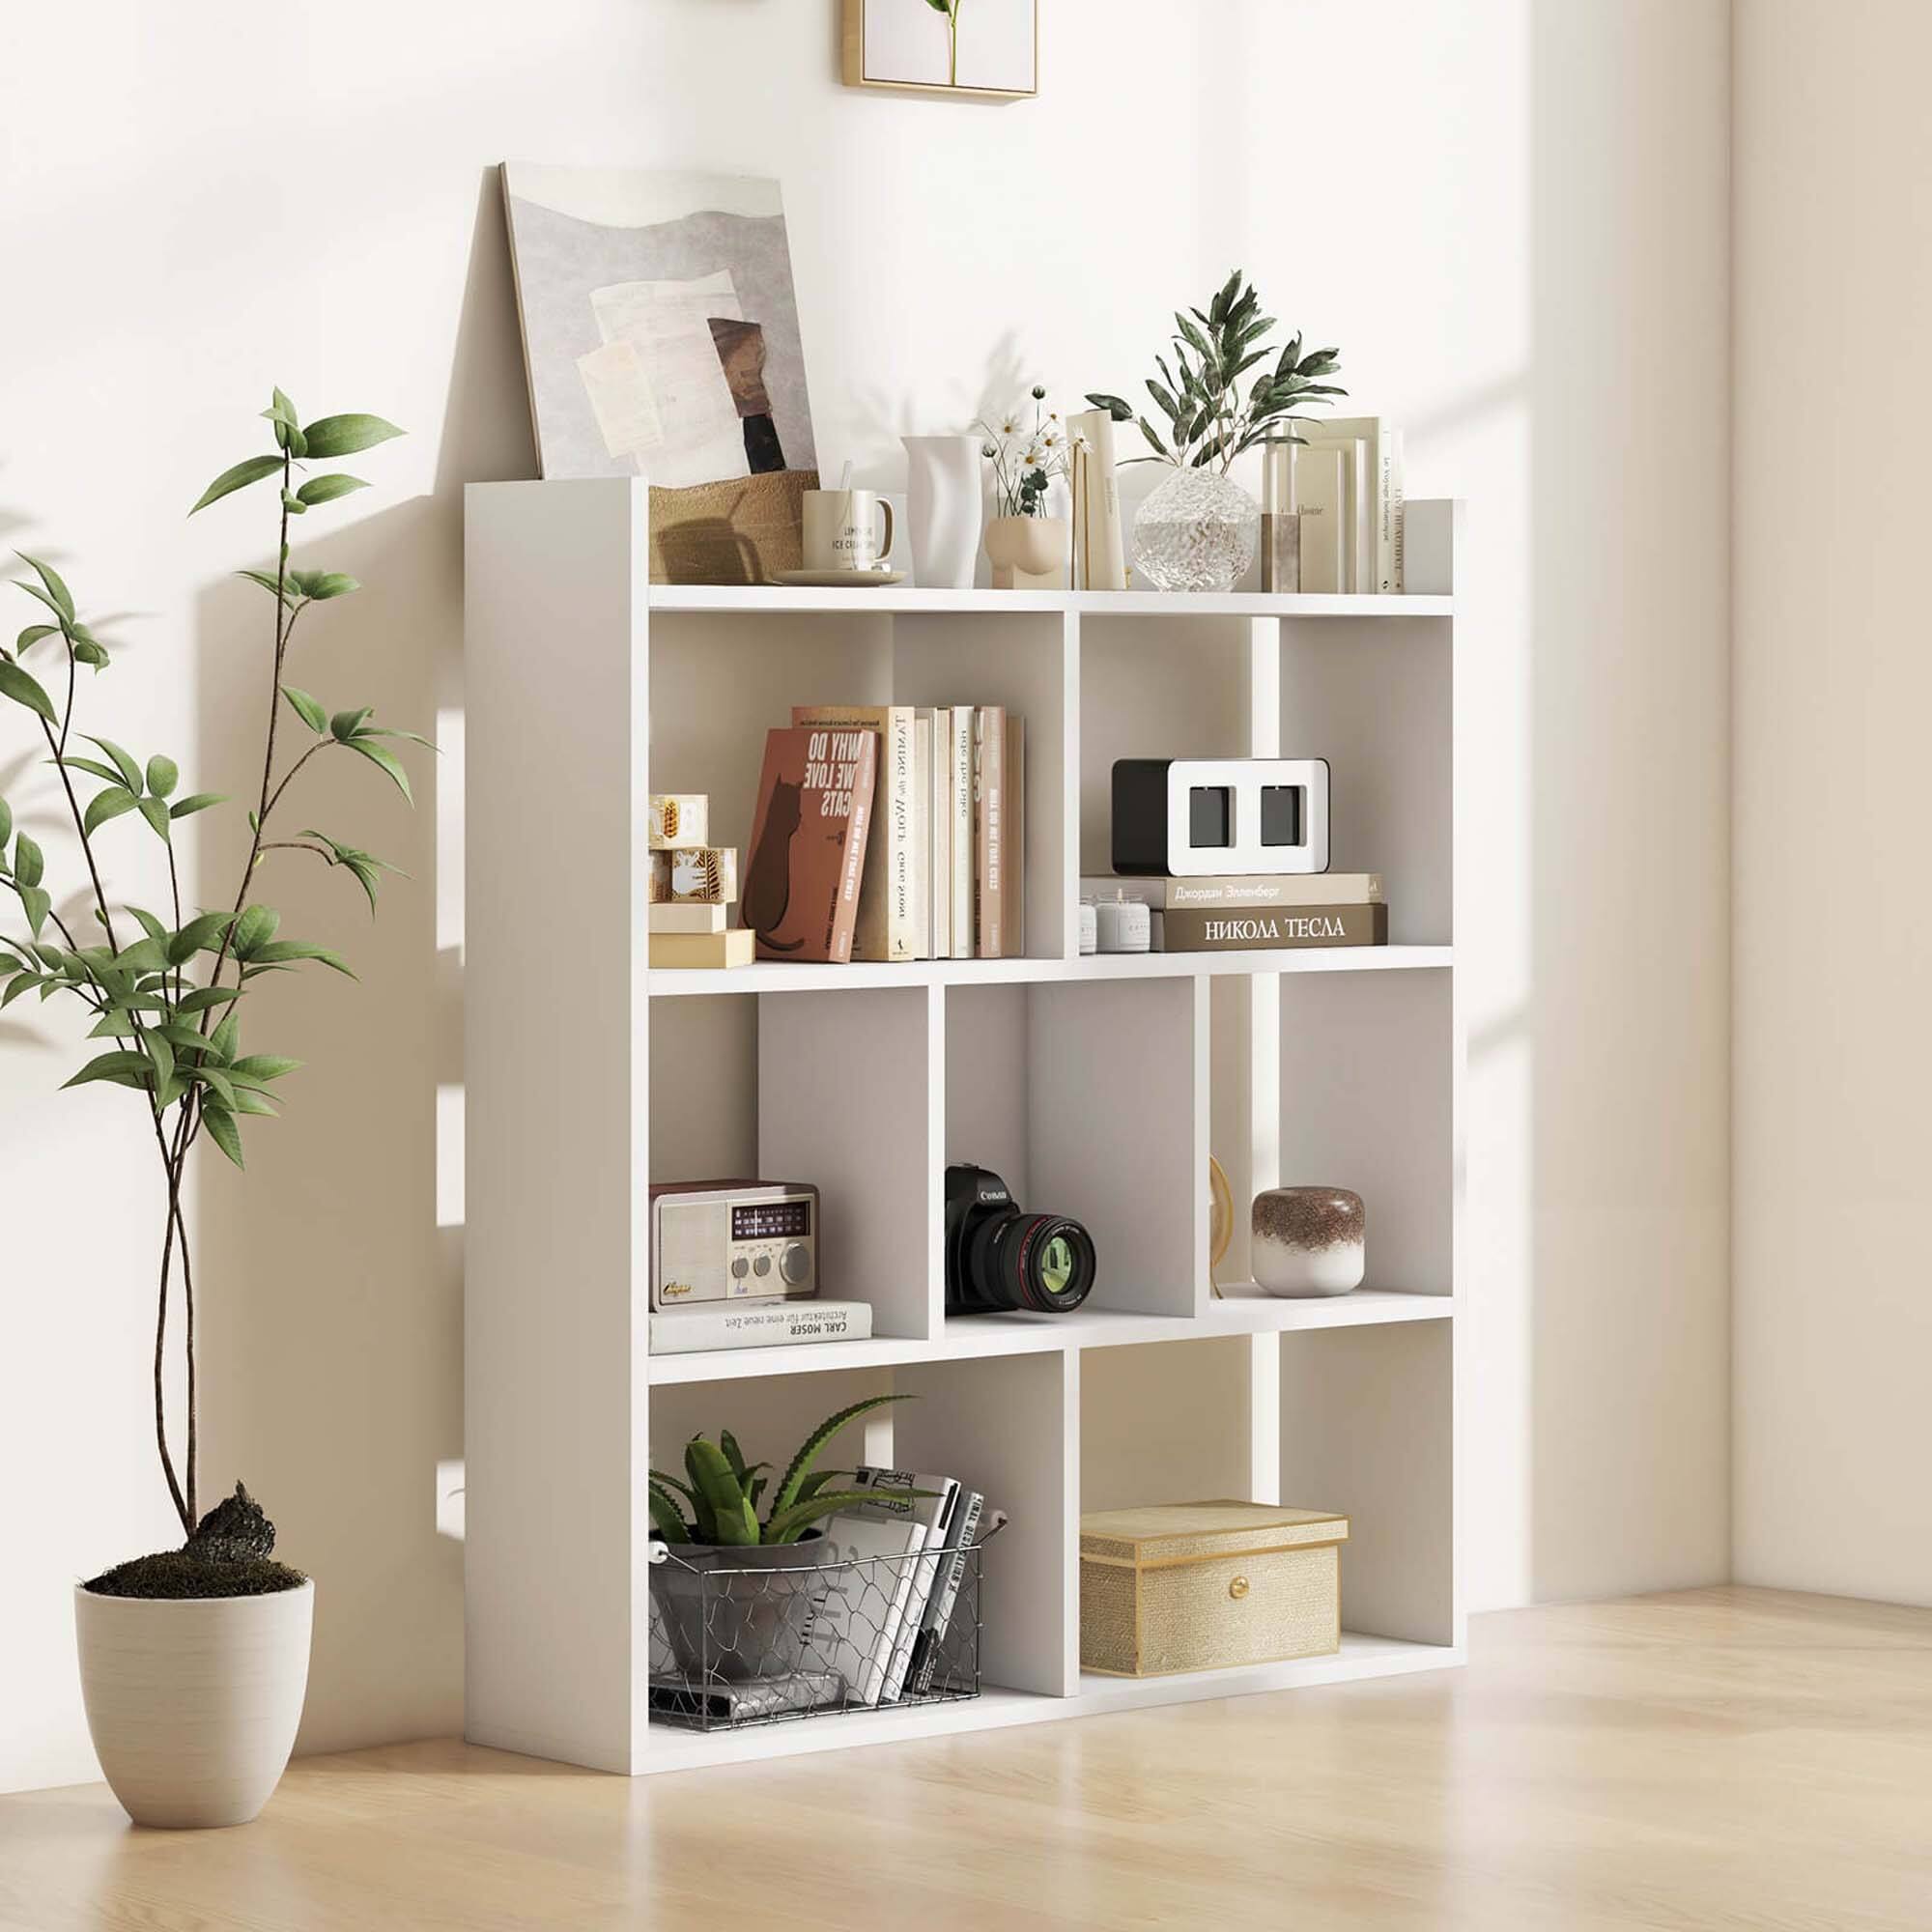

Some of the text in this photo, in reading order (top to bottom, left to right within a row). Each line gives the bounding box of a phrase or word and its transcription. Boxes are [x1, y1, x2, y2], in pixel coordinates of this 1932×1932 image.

[1174, 882, 1280, 900] Джордан Элленберг
[1205, 917, 1346, 940] НИКОЛА ТЕСЛА
[725, 1311, 848, 1329] Architektur für eine neue Zeit
[790, 1321, 847, 1336] CARL MOSER
